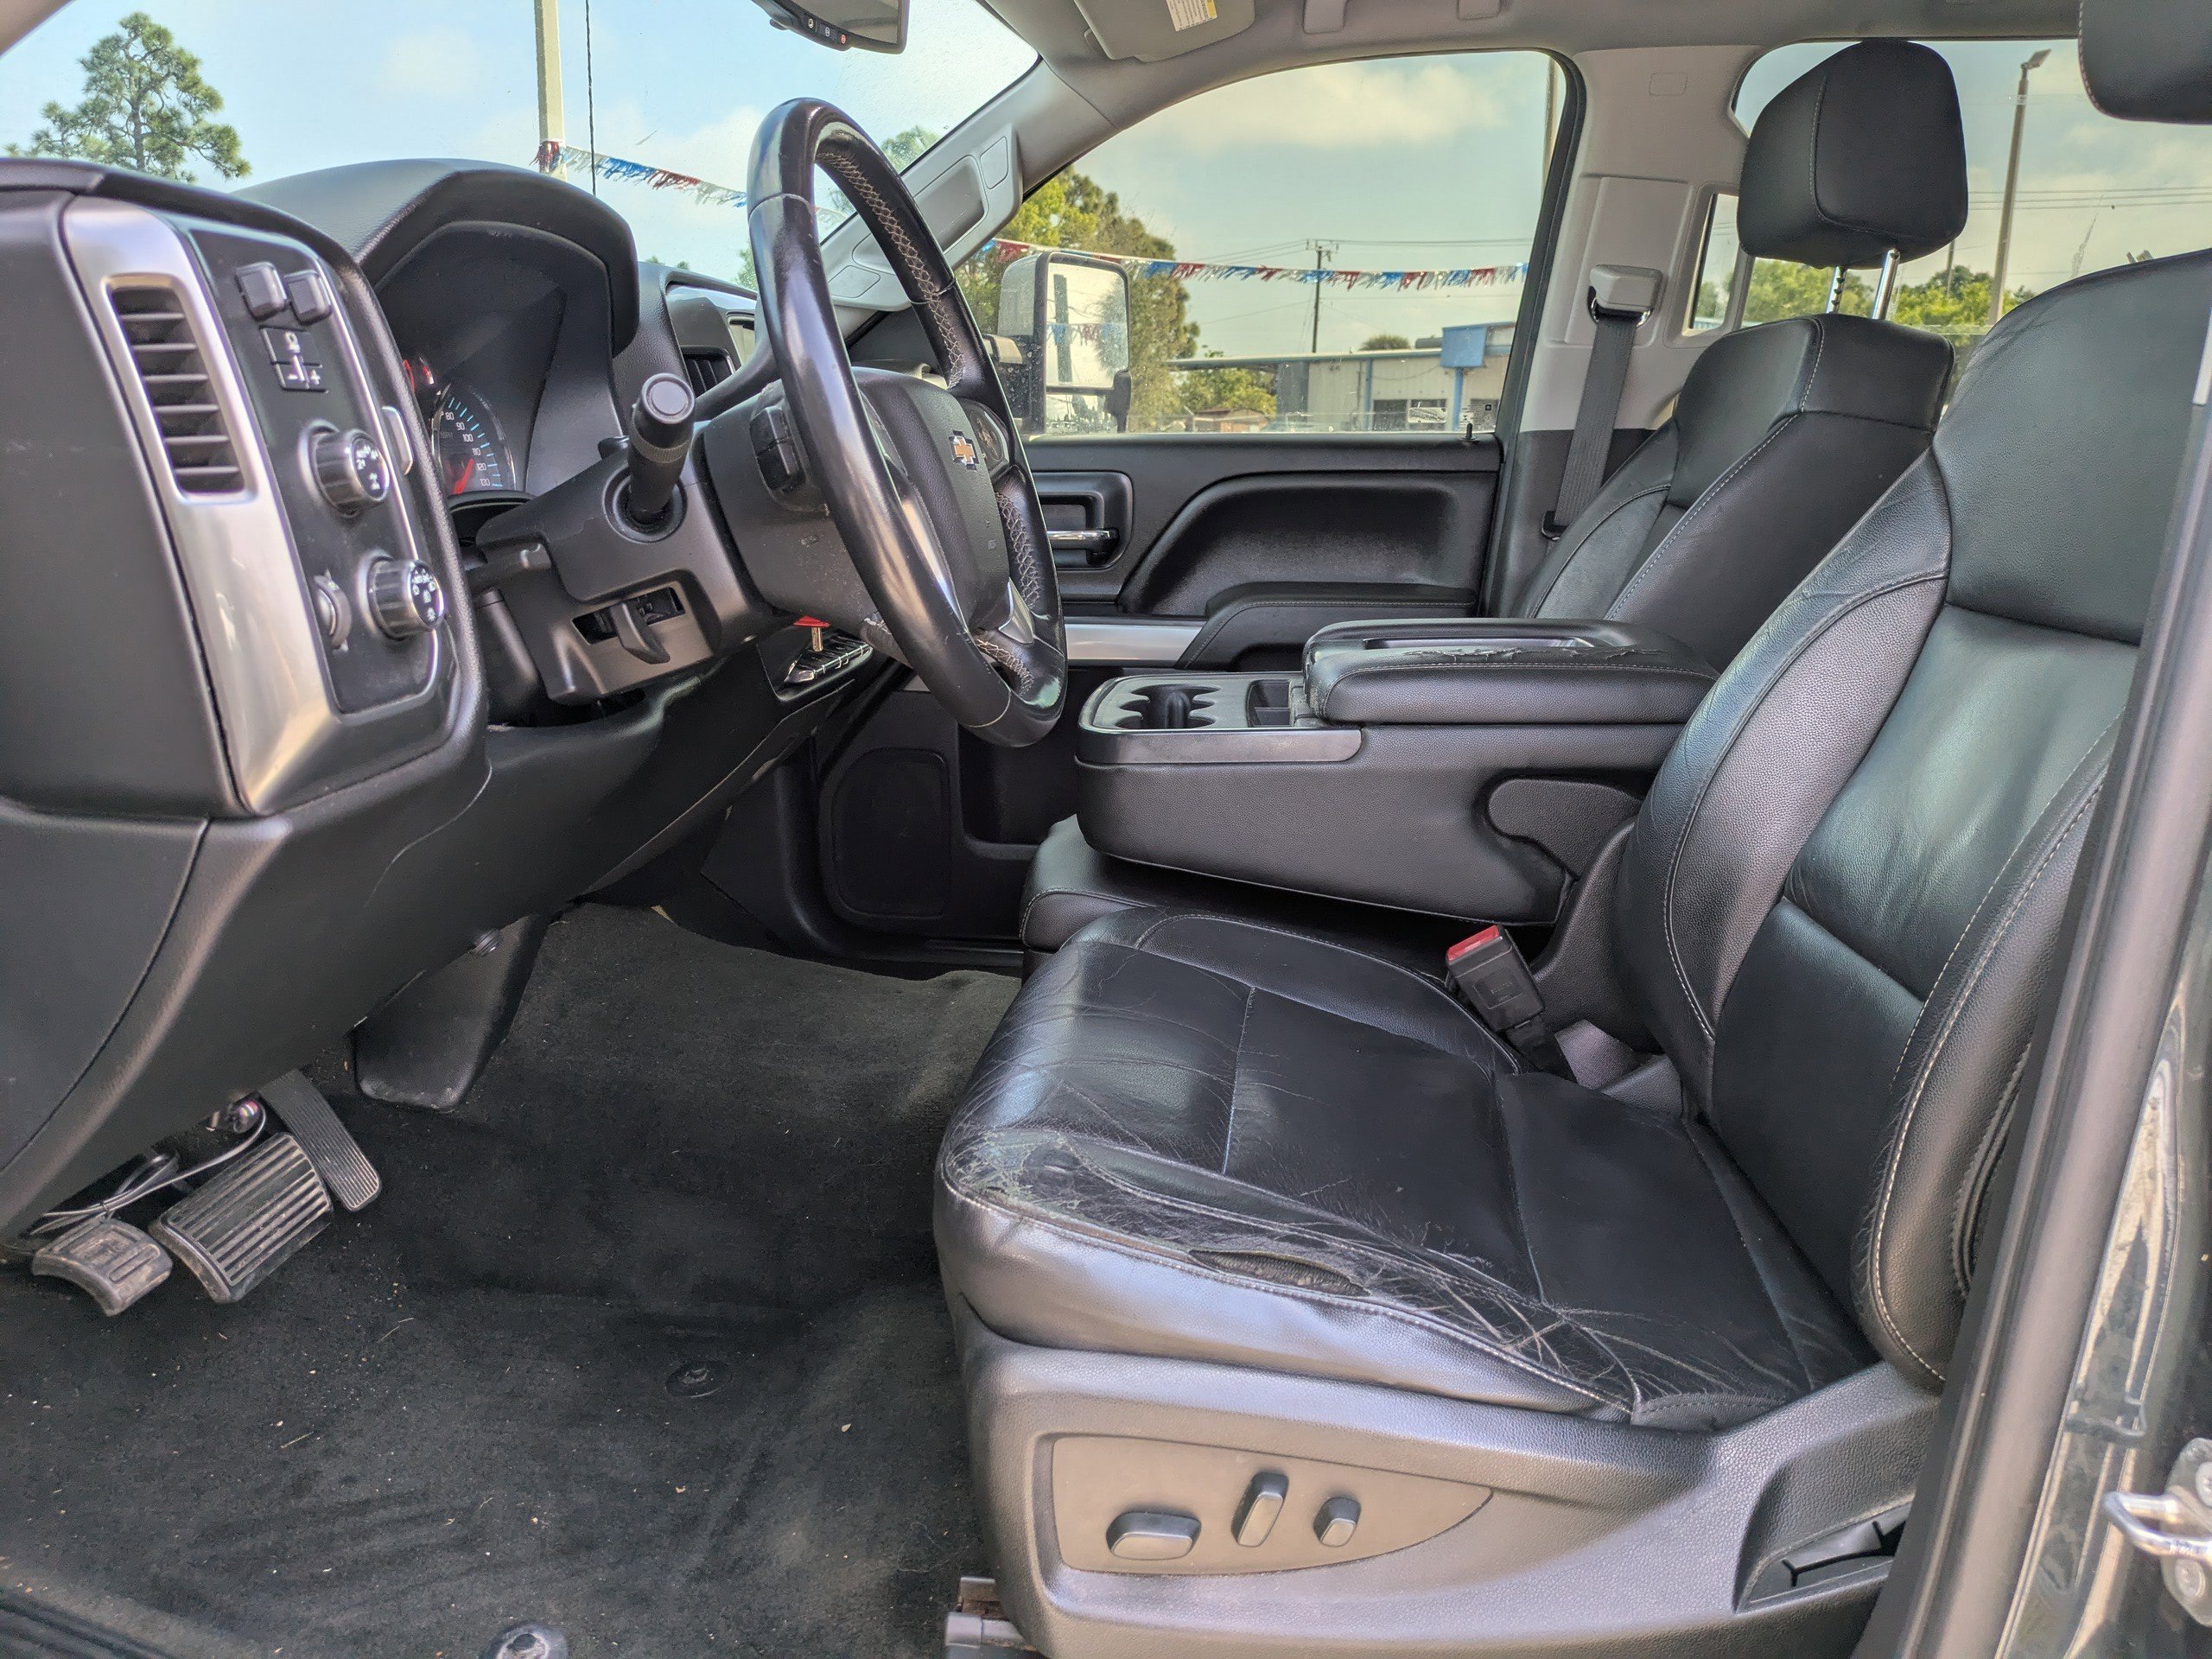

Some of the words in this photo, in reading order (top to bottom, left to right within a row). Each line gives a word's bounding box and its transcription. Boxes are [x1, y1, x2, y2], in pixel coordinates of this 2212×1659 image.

[445, 411, 454, 421] 80
[455, 422, 466, 431] 90
[462, 433, 474, 442] 100
[472, 448, 481, 456] 110
[476, 462, 487, 472] 120
[480, 478, 491, 486] 130
